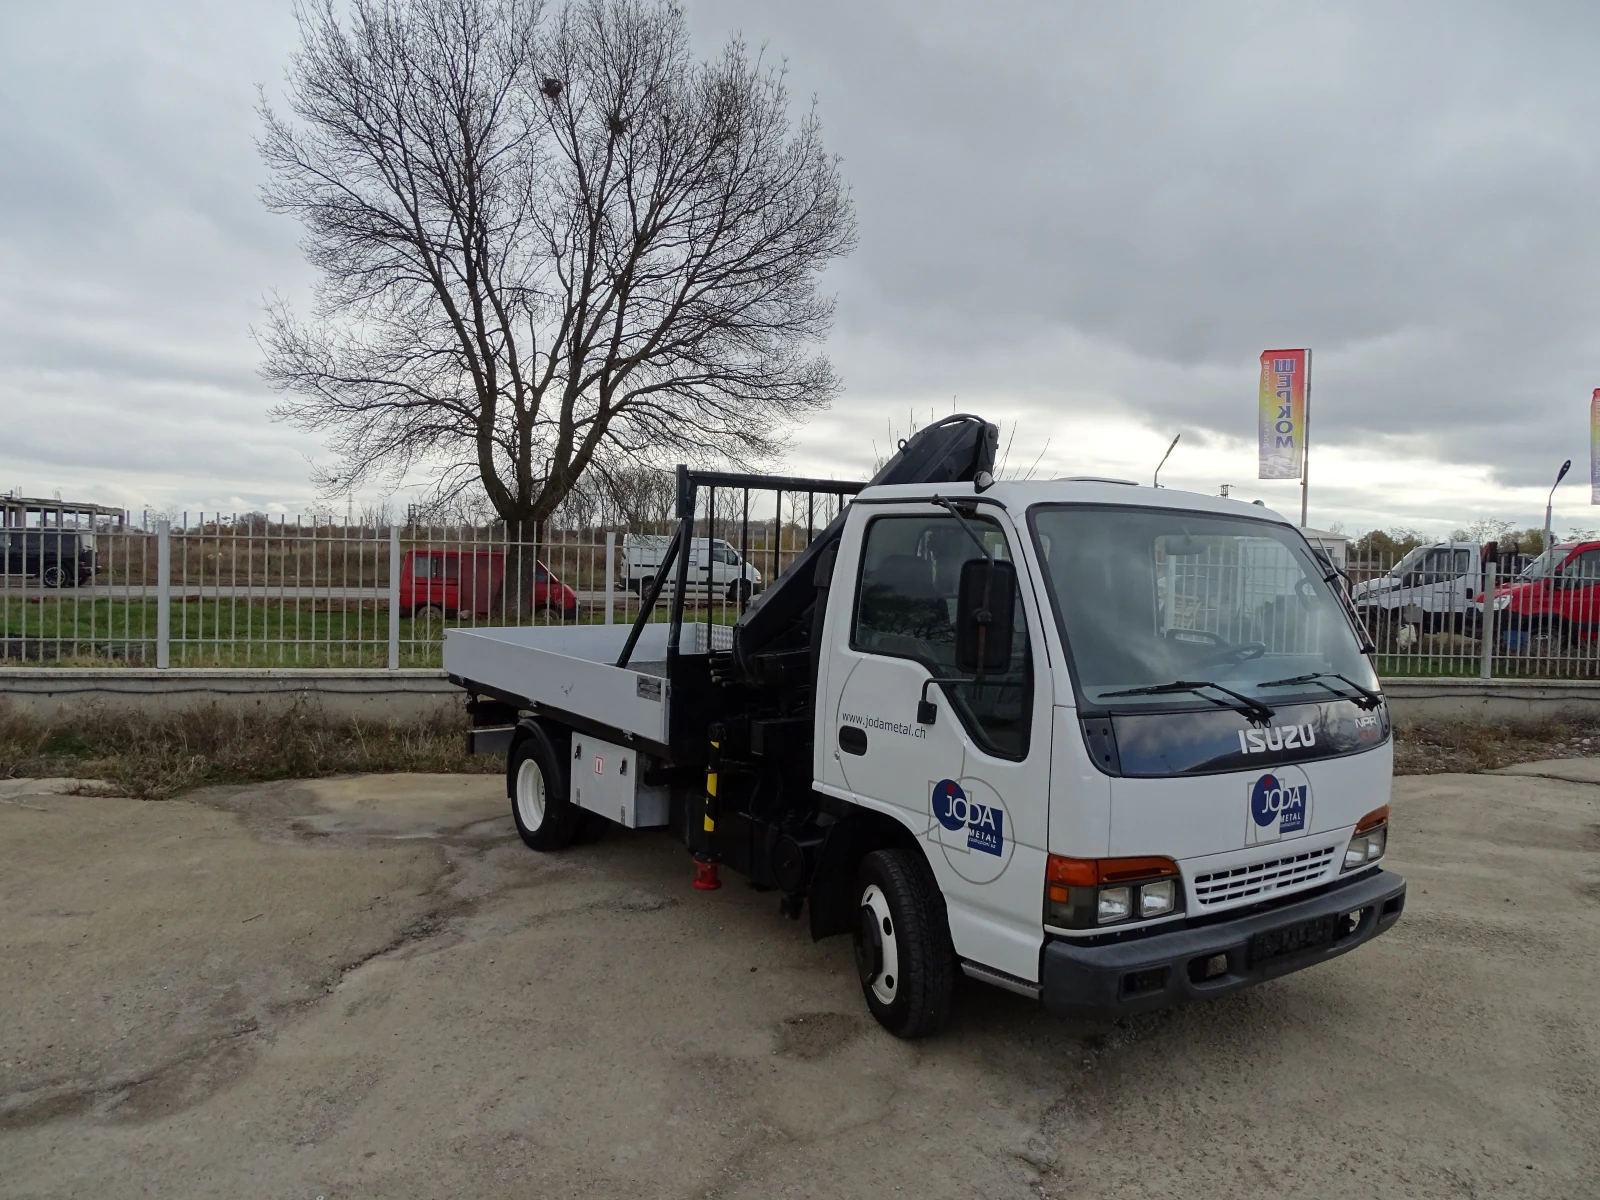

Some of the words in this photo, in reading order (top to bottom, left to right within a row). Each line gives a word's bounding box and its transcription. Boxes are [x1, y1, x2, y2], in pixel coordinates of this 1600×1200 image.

[842, 712, 926, 740] www.jodametal.ch
[1354, 716, 1378, 730] NPR
[1238, 723, 1316, 755] ISUZU
[945, 795, 996, 831] JODA
[1262, 786, 1302, 814] JODA
[968, 828, 997, 844] METAL
